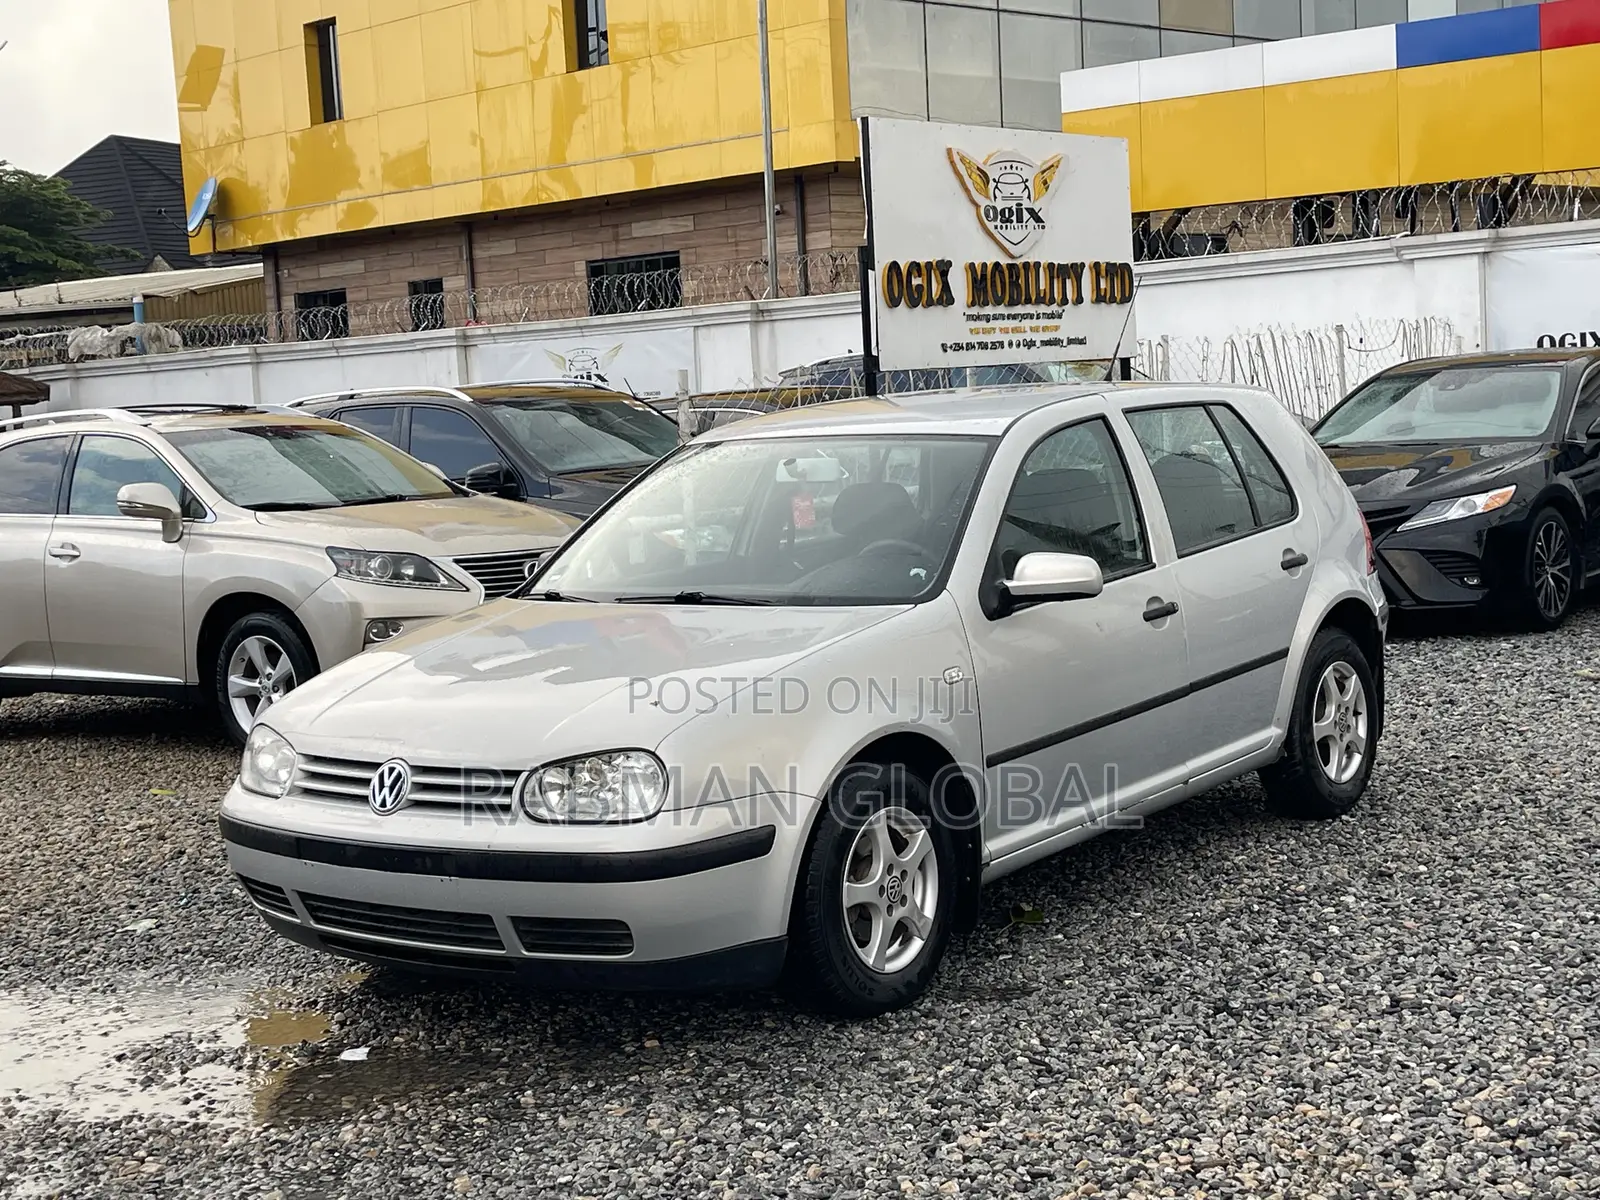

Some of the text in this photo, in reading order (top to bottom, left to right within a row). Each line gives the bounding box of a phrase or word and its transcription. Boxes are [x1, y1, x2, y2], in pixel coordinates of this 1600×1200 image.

[984, 202, 1045, 224] Ogix
[882, 259, 1134, 308] OGIX MOBILITY LTD
[1006, 312, 1035, 322] everyone
[1035, 310, 1041, 320] is
